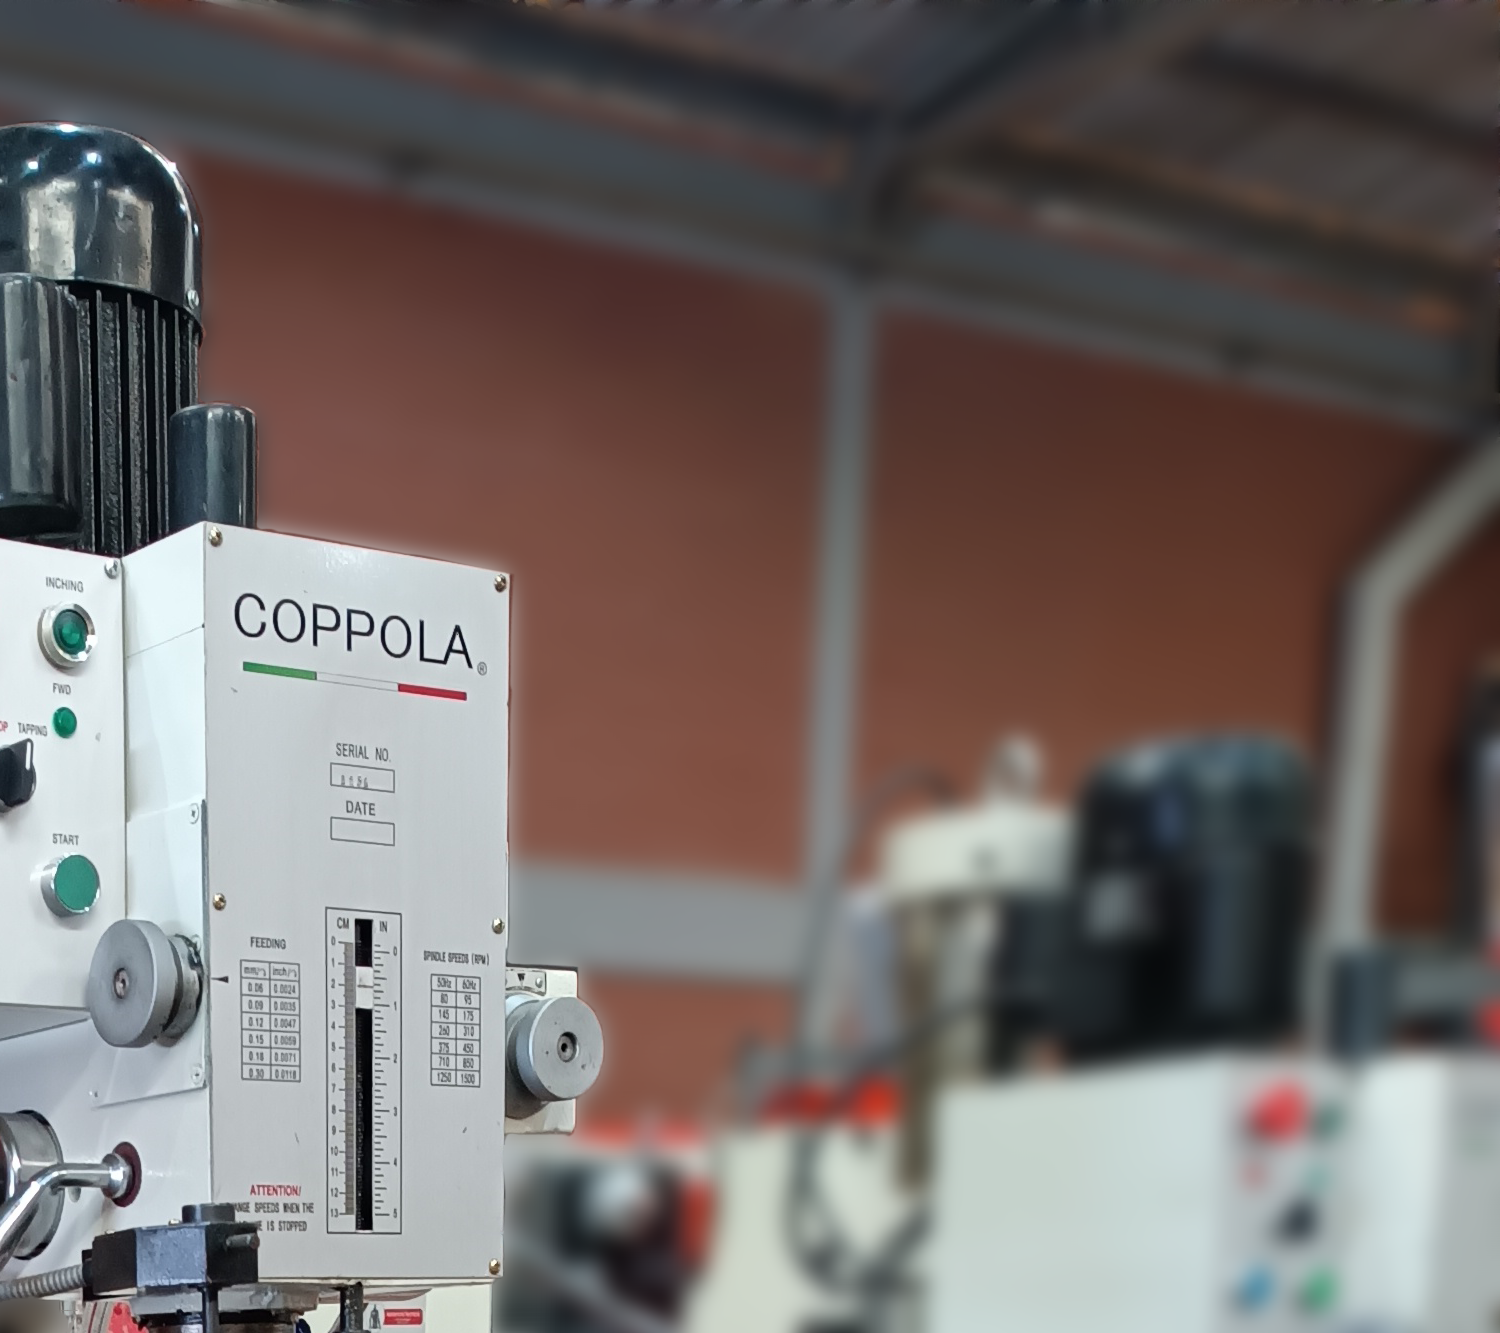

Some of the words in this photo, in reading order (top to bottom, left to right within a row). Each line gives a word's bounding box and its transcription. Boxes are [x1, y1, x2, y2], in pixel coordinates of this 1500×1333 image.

[45, 576, 84, 593] INCHING
[233, 592, 474, 669] COPPOLA
[52, 683, 72, 695] FWD
[17, 722, 48, 737] TAPPING
[336, 742, 369, 760] SERIAL
[375, 747, 392, 763] NO.
[346, 800, 376, 816] DATE
[52, 833, 79, 846] START
[337, 917, 349, 929] CM
[379, 921, 388, 933] IN
[250, 936, 286, 950] FEEDING
[423, 950, 446, 963] SPINDLE
[448, 952, 469, 964] SPEEDS
[471, 953, 489, 966] (RPM)
[464, 994, 472, 1005] 95
[439, 1009, 449, 1020] 145
[463, 1010, 474, 1021] 175
[248, 1016, 264, 1027] 0.12
[463, 1026, 474, 1037] 310
[248, 1033, 264, 1044] 0.15
[439, 1056, 450, 1067] 710
[254, 1202, 280, 1213] SPEEDS
[283, 1202, 300, 1213] WHEN
[302, 1202, 314, 1213] THE
[266, 1221, 274, 1231] IS
[278, 1221, 307, 1232] STOPPED
